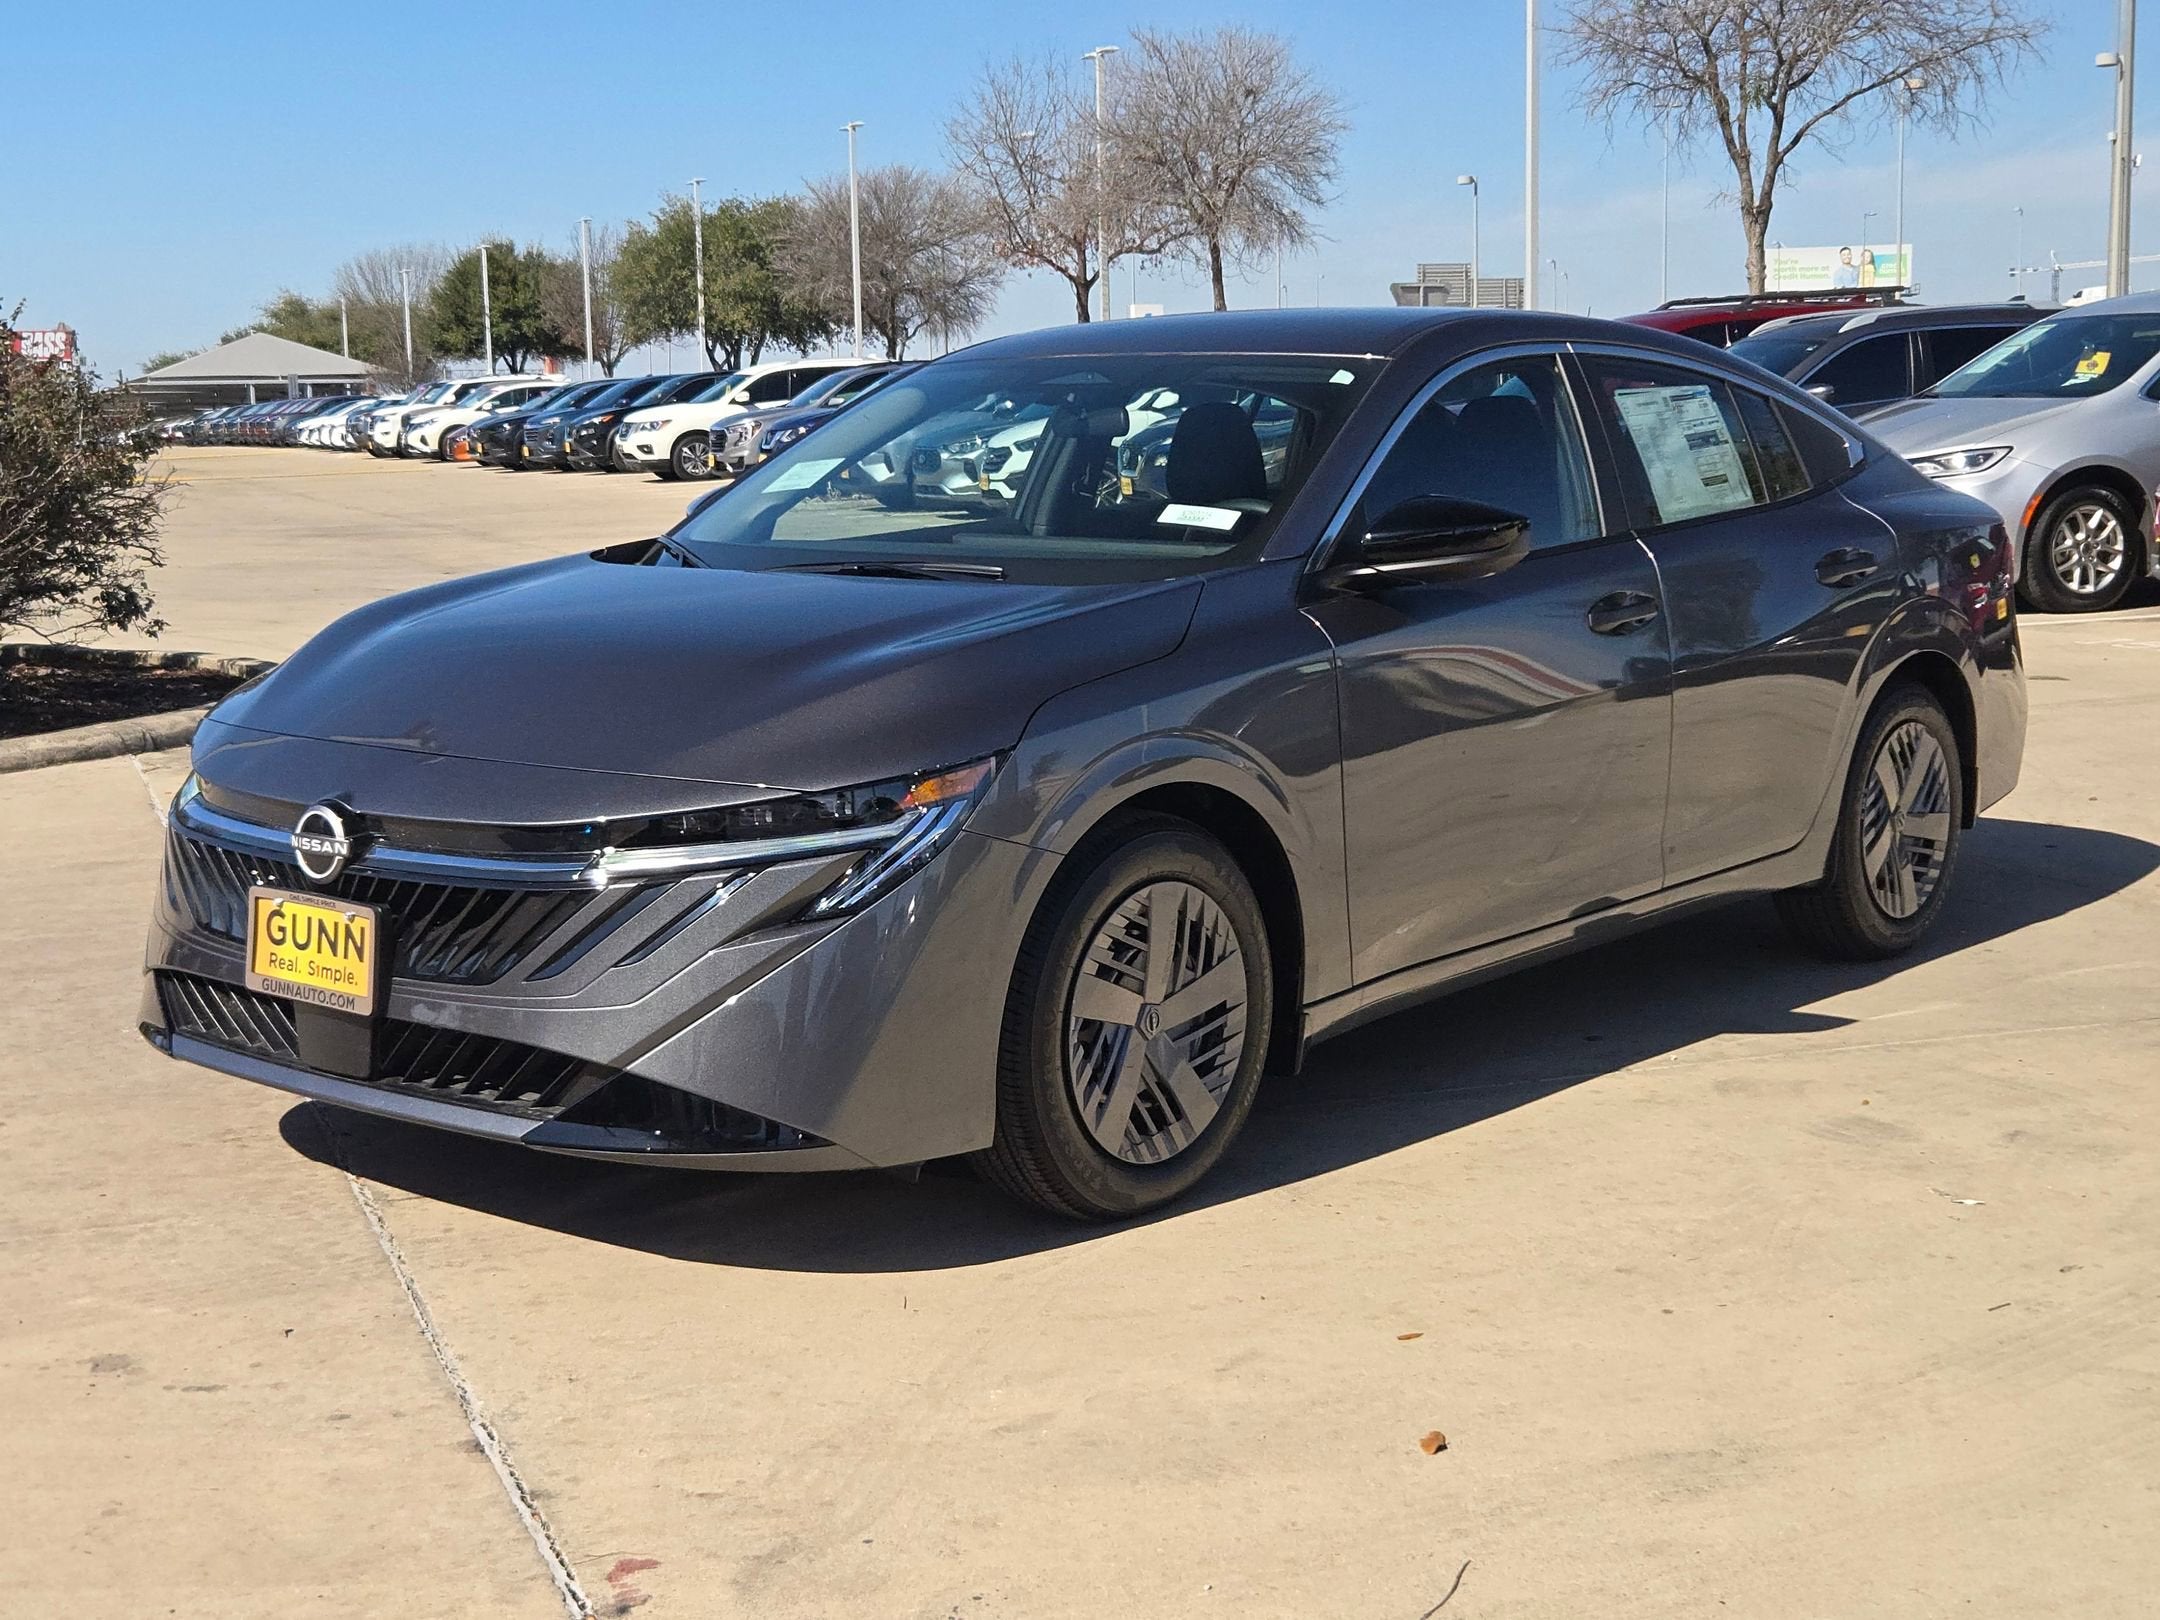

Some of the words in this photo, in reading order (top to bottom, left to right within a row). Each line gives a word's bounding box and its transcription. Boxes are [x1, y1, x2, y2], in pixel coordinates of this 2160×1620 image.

[291, 834, 348, 855] NISSAN
[266, 908, 366, 963] GUNN
[268, 952, 302, 975] Real.
[308, 961, 359, 987] Simple.
[262, 977, 356, 1011] GUNNAUTO.COM
